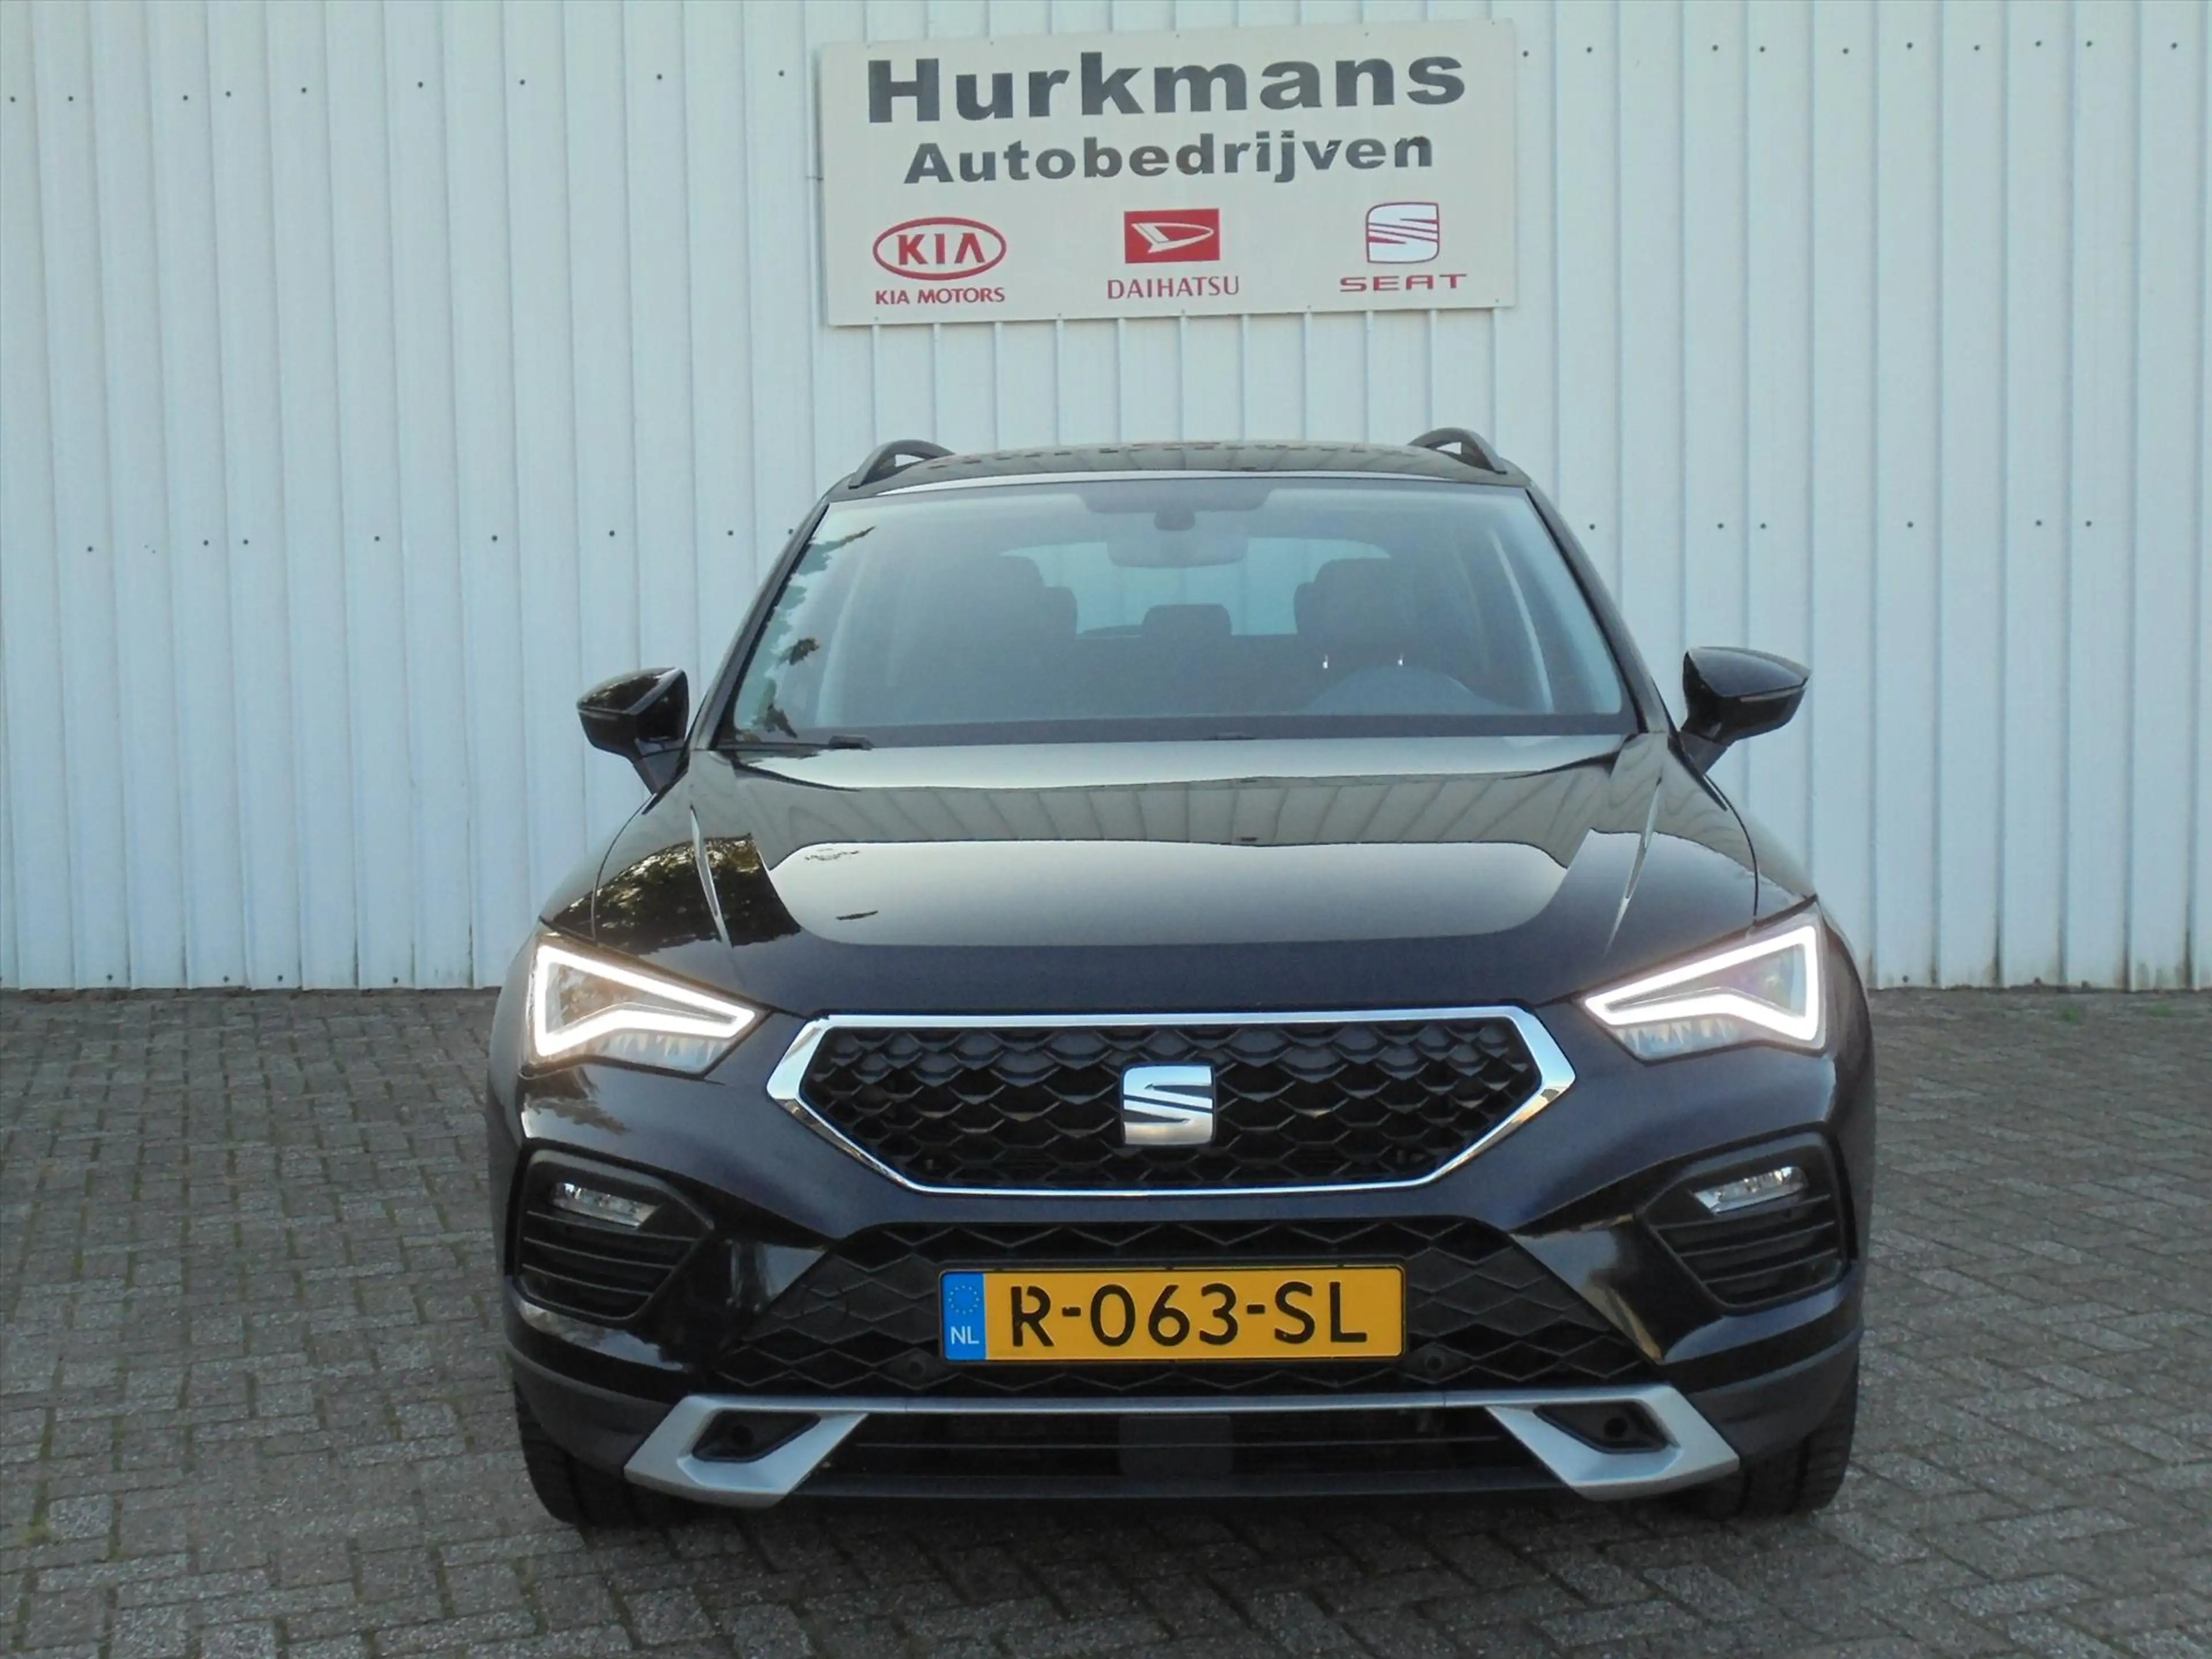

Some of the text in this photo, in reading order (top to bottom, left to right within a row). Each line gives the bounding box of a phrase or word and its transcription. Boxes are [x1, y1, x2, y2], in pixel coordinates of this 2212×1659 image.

[868, 51, 1465, 123] Hurkmans
[903, 130, 1433, 184] Autobedrijven
[897, 233, 986, 265] KIA
[875, 287, 1005, 304] KIA MOTORS
[1107, 276, 1239, 299] DAIHATSU
[1340, 274, 1467, 292] SEAT
[1010, 1281, 1368, 1347] R-063-SL
[951, 1325, 979, 1344] NL
